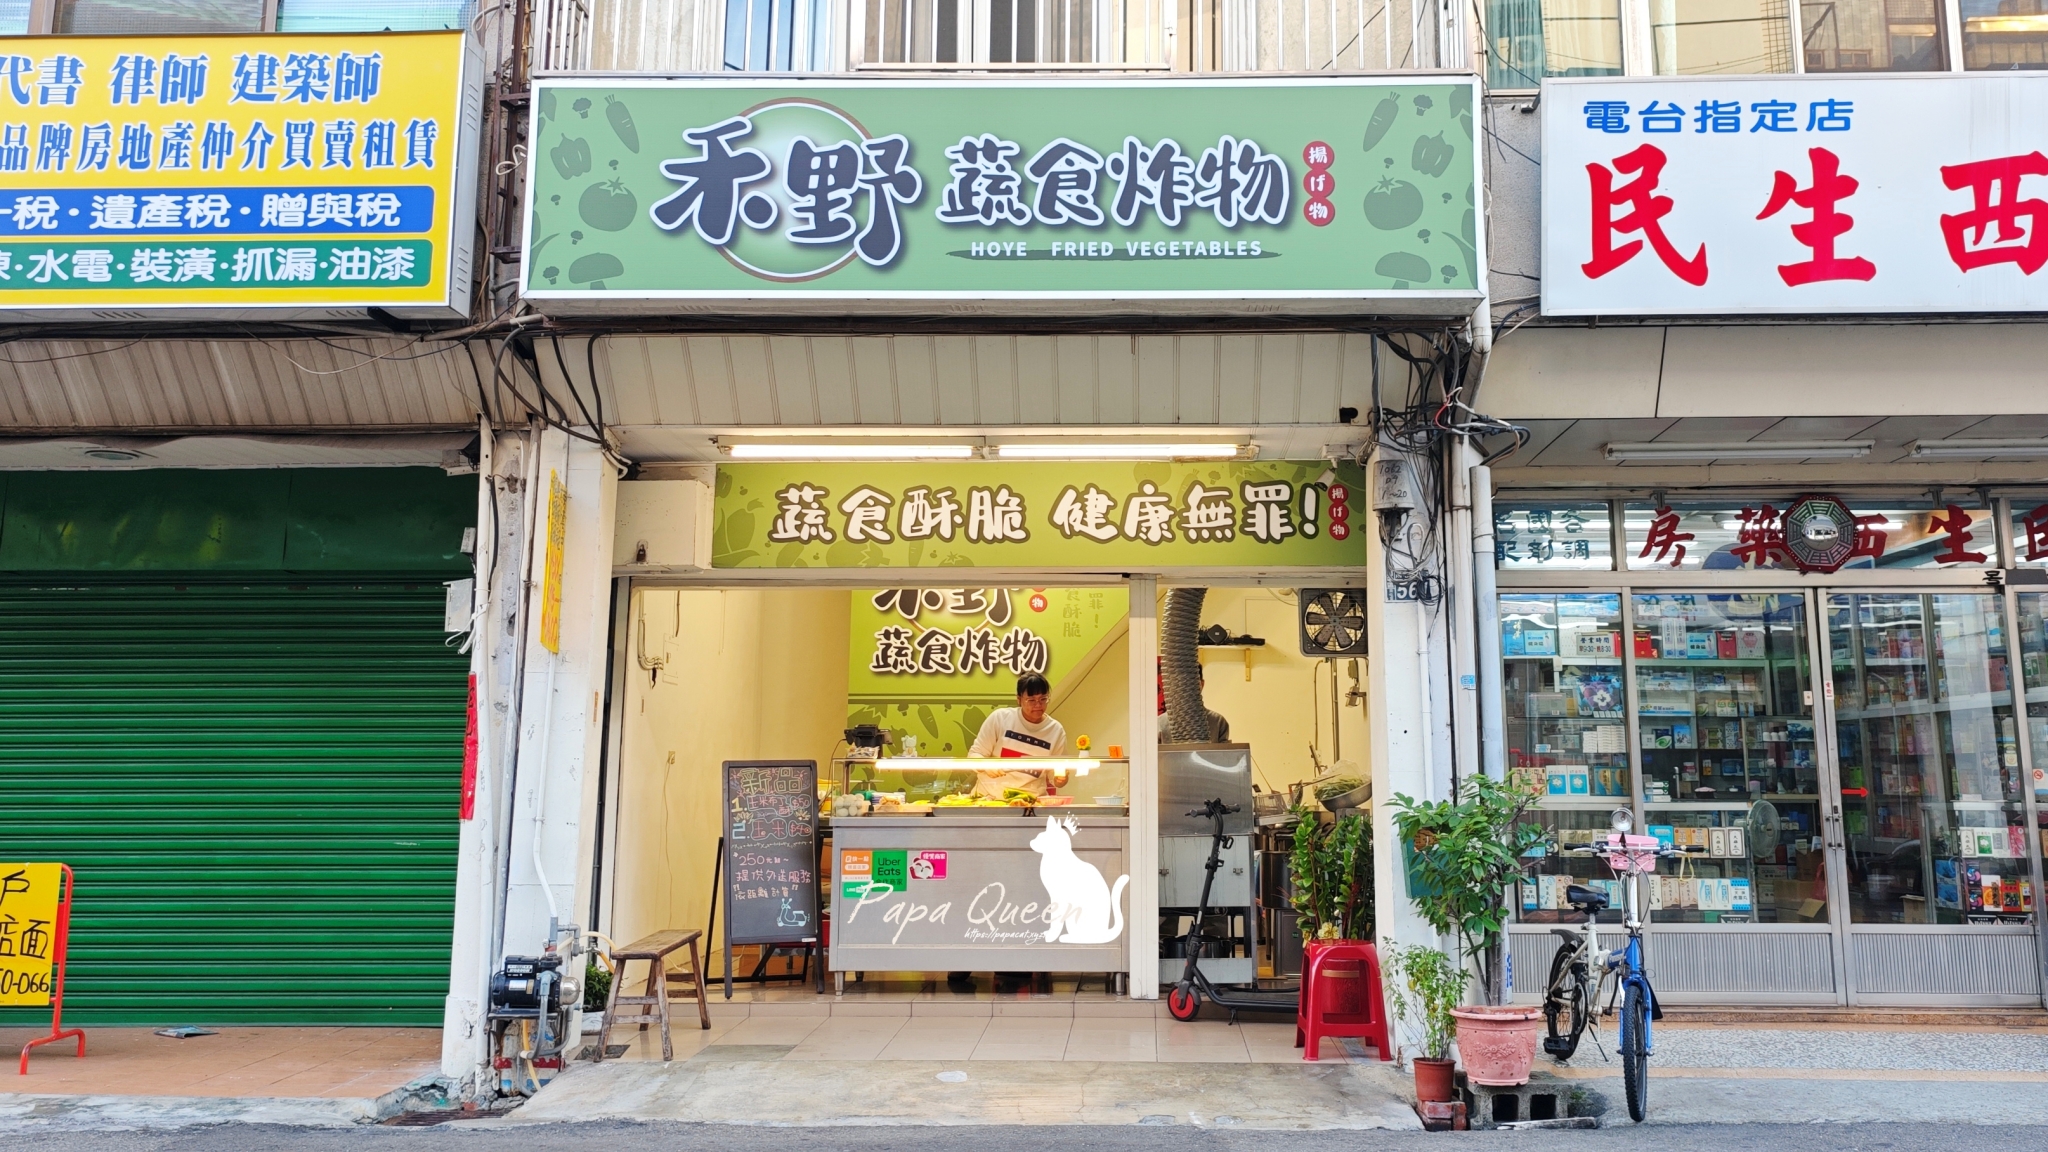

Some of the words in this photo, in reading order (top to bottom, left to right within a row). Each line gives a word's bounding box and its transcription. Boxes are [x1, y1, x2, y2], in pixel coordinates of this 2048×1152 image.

[110, 53, 208, 104] 律師
[231, 52, 382, 103] 建築師
[1582, 99, 1854, 134] 電台指定店
[0, 119, 437, 171] 品牌房地產仲介買賣租賃
[650, 116, 922, 266] 禾野
[936, 134, 1290, 228] 蔬食炸物
[0, 192, 402, 230] 稅·遺產稅·贈與稅
[970, 241, 1028, 257] HOYE
[1051, 241, 1114, 257] FRIED
[1126, 240, 1262, 256] VEGETABLES
[770, 482, 1030, 544] 蔬食酥脆
[869, 626, 1048, 674] 蔬食炸物
[1009, 732, 1047, 748] TOMMY
[877, 858, 901, 867] Uber
[877, 867, 901, 876] Eats
[0, 969, 50, 994] 0-066
